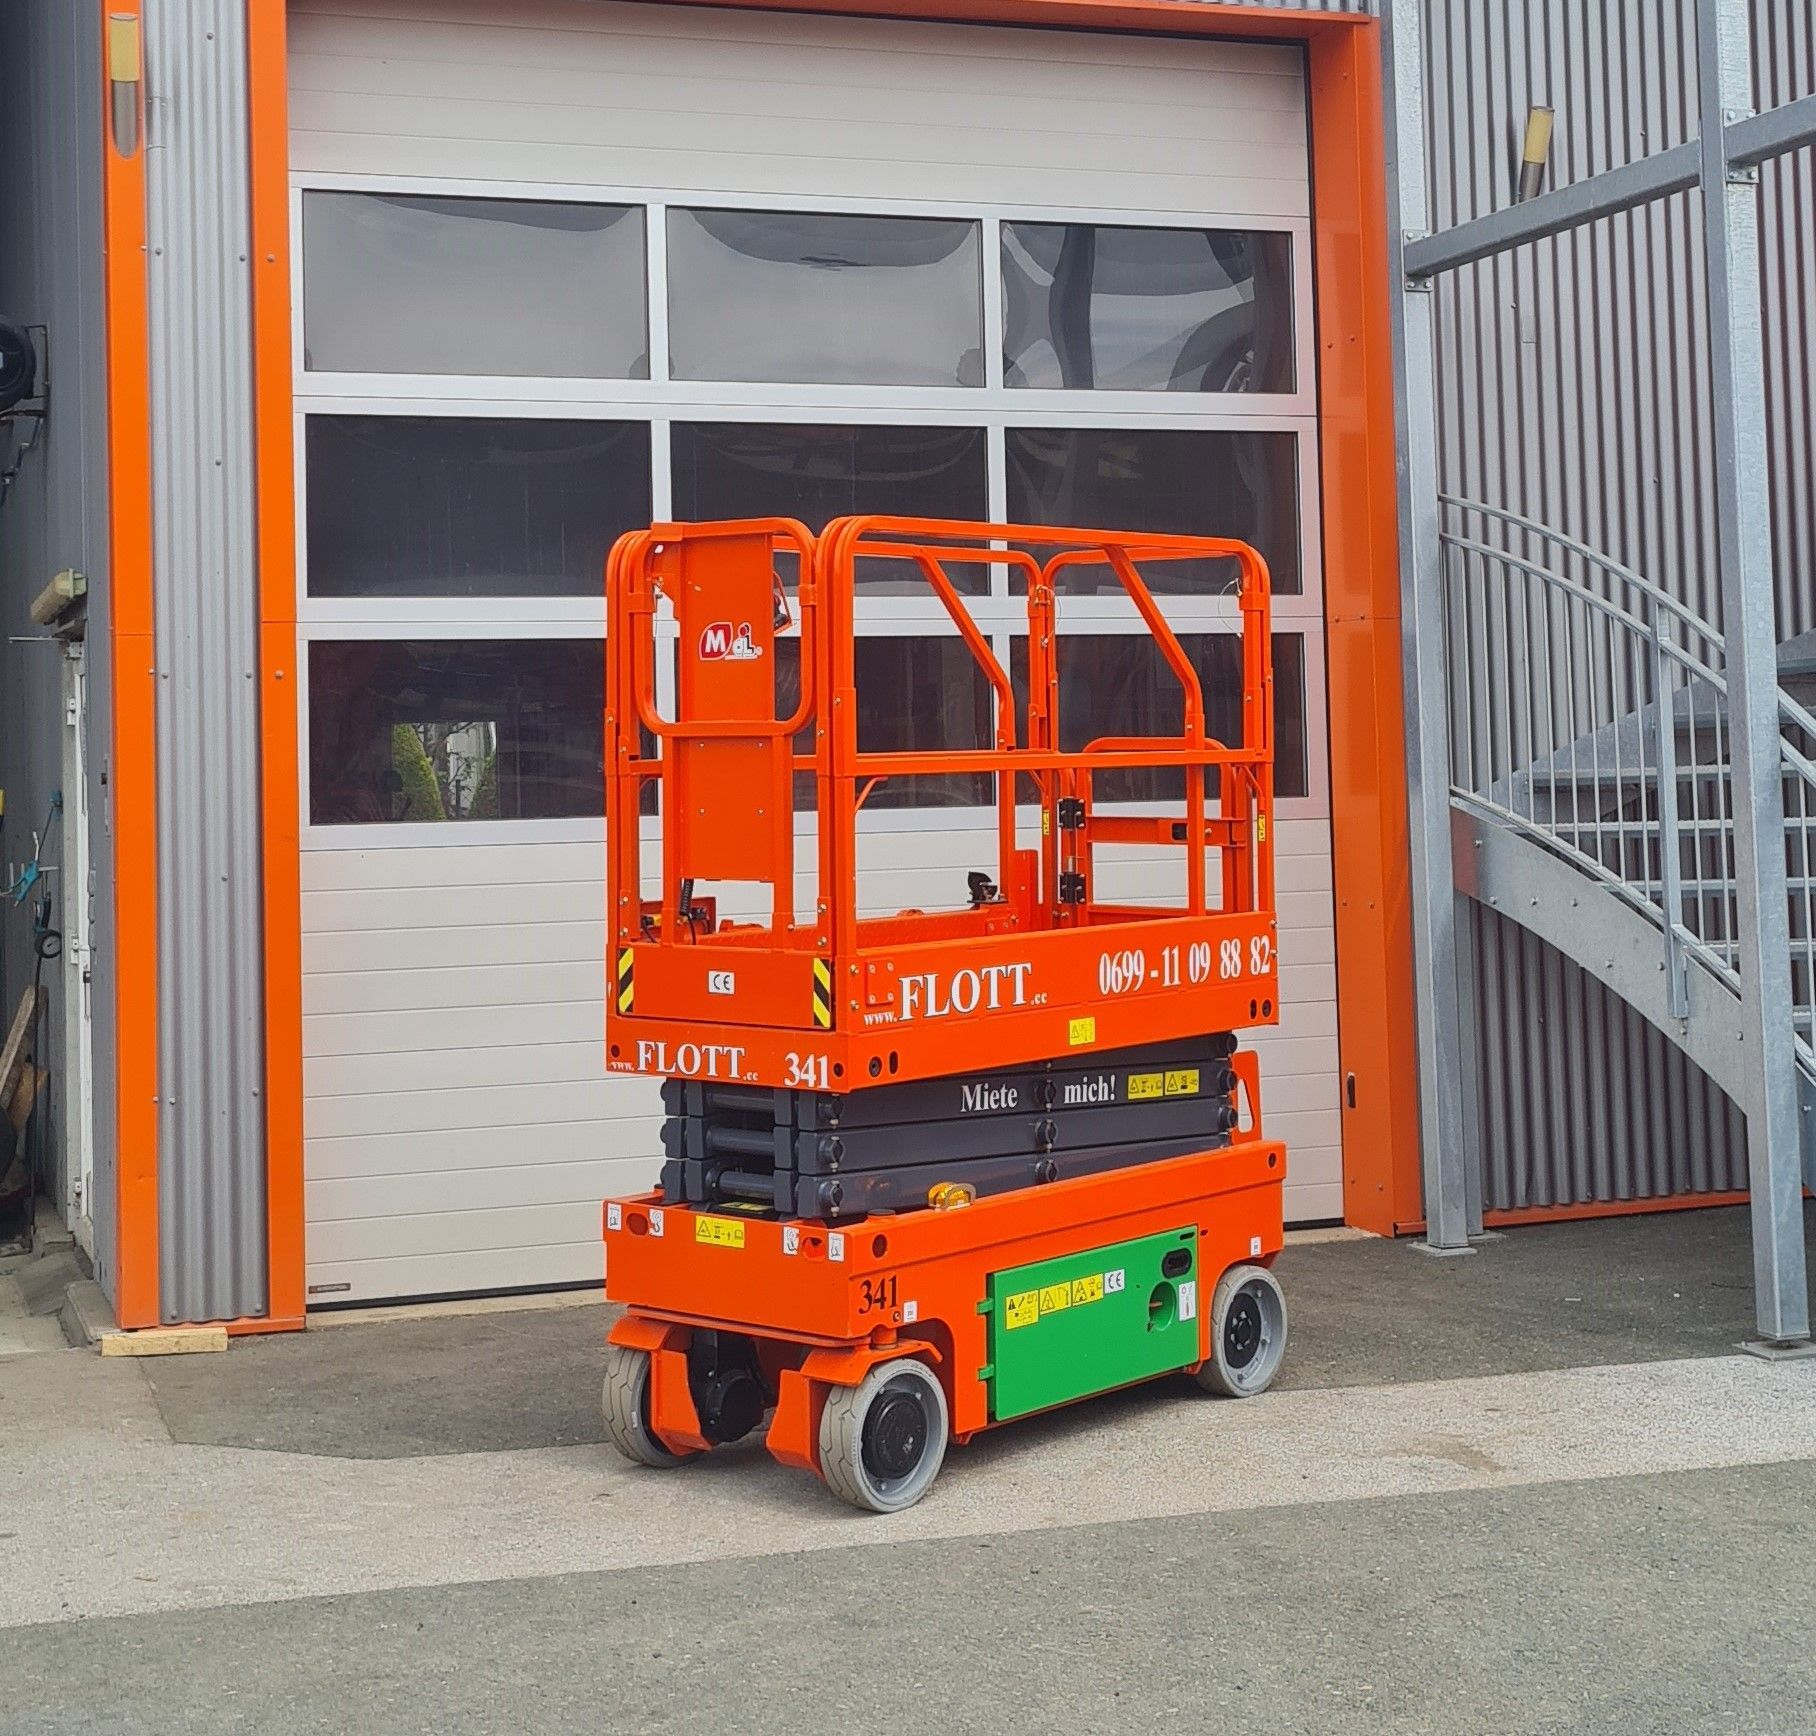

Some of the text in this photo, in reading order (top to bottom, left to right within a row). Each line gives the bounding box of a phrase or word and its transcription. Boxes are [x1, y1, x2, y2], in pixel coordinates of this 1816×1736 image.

[1098, 949, 1146, 995] 0699
[1188, 941, 1211, 984] 09
[1219, 938, 1242, 980] 88
[1250, 934, 1271, 976] 82
[783, 1052, 832, 1090] 341
[960, 1074, 1116, 1113] Miete mich!
[858, 1274, 898, 1315] 341
